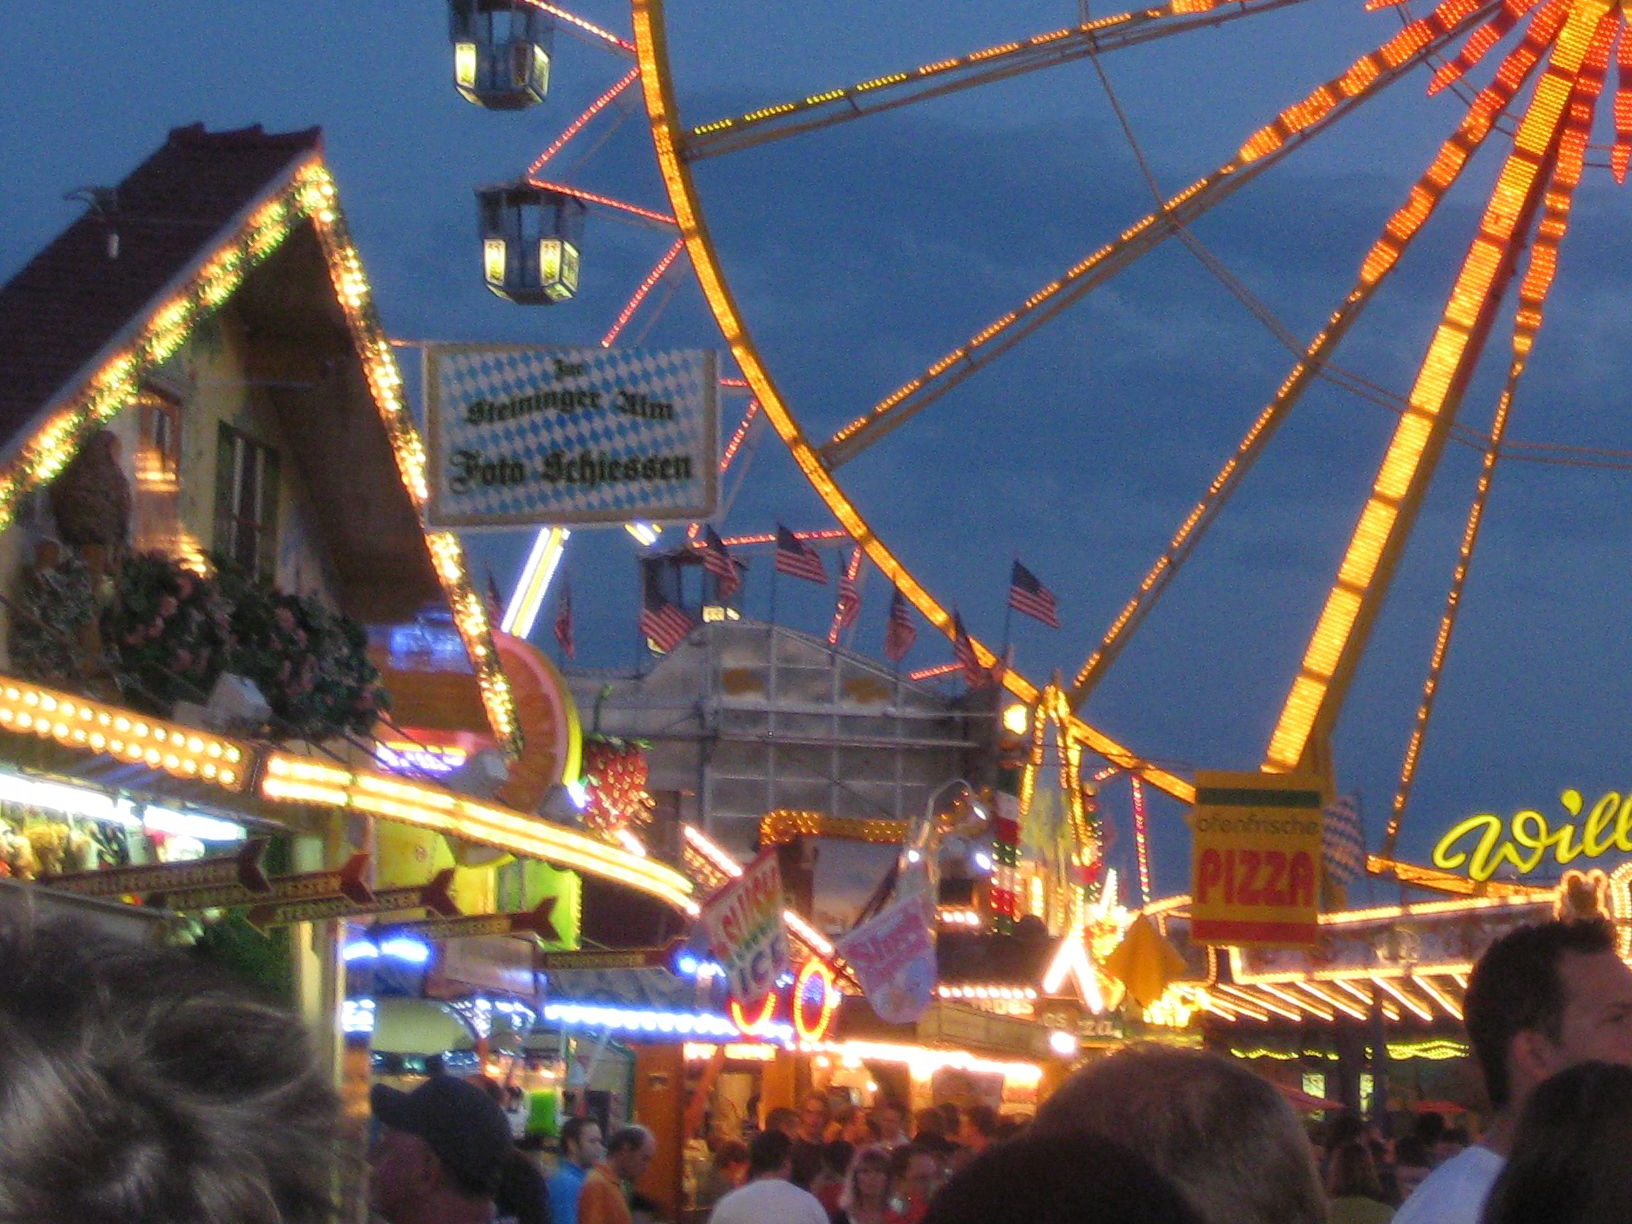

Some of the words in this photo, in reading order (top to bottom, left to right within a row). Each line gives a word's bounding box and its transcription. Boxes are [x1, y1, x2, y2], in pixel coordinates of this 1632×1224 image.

[464, 390, 602, 426] Steininger
[615, 388, 674, 421] Alm
[450, 449, 525, 496] Foto
[540, 448, 692, 490] Schiessen
[1197, 811, 1320, 836] ofenfrische
[1196, 847, 1315, 908] PIZZA
